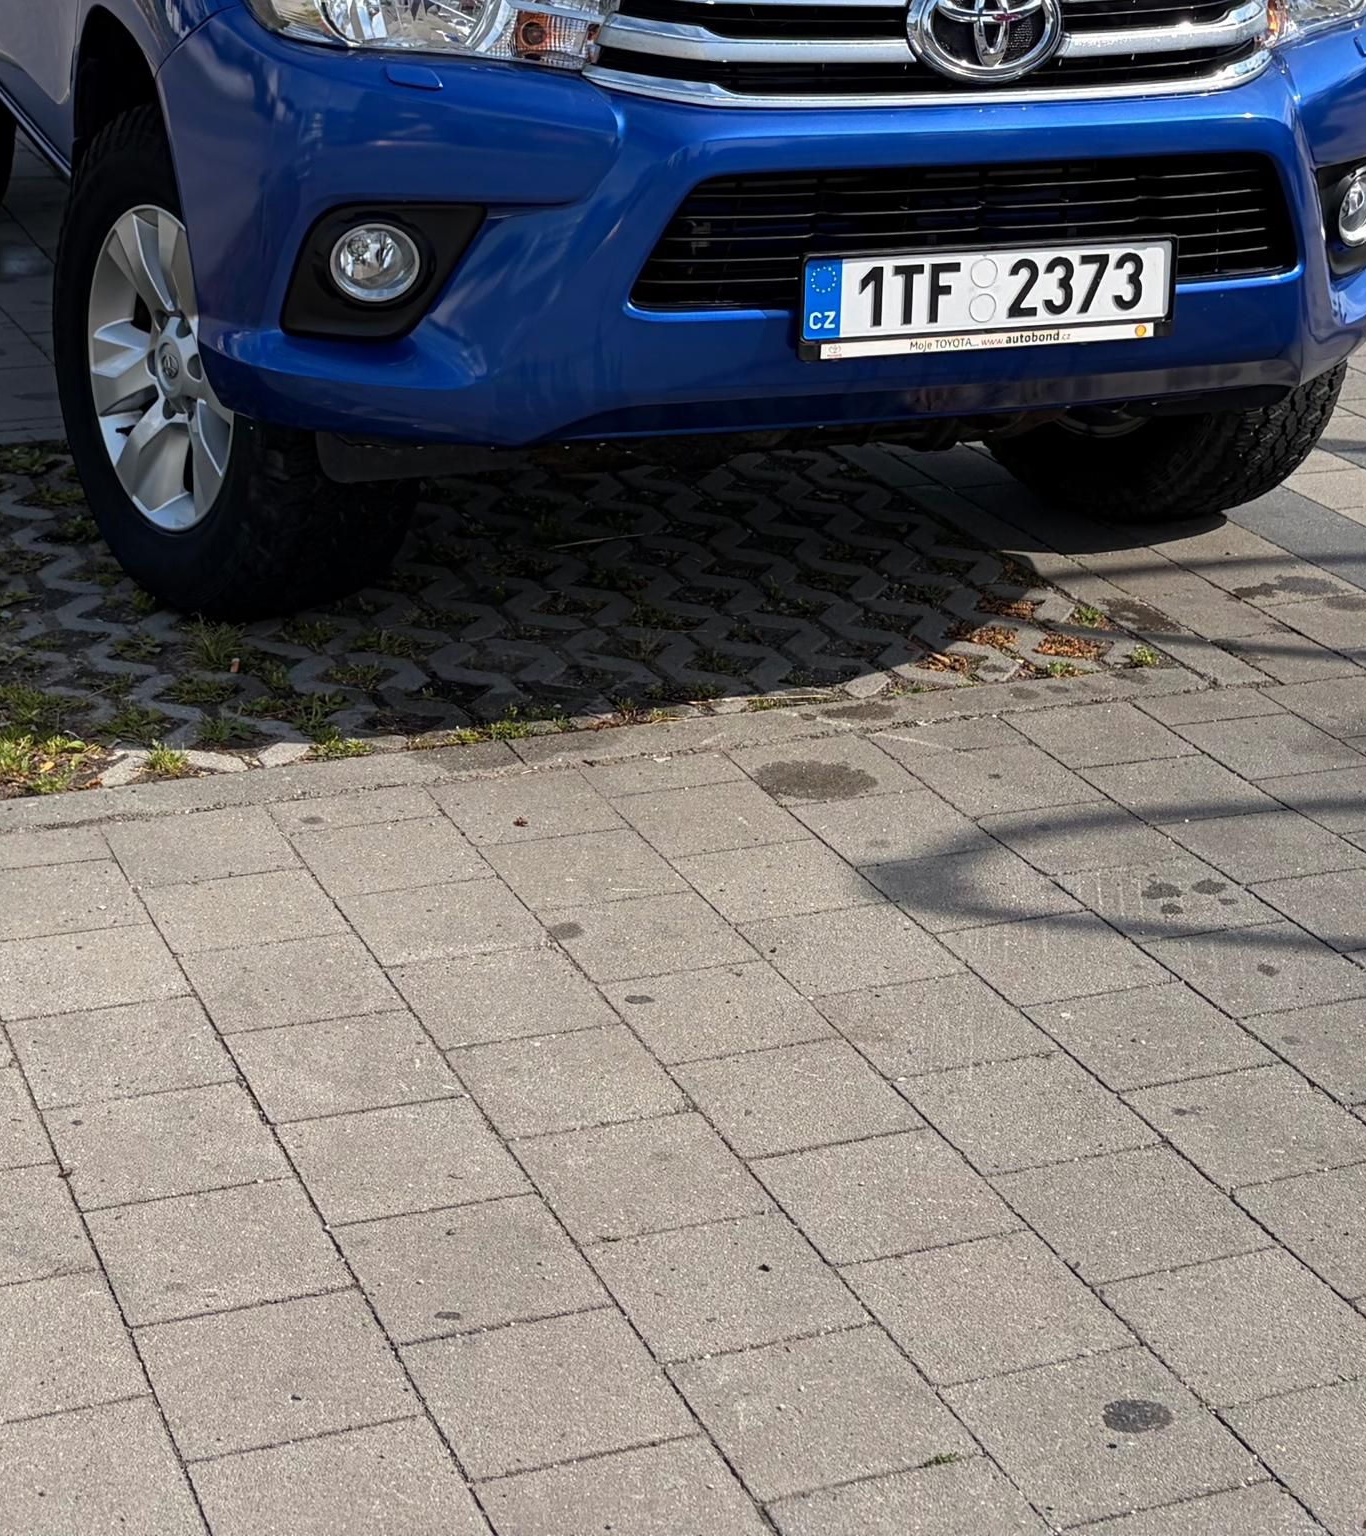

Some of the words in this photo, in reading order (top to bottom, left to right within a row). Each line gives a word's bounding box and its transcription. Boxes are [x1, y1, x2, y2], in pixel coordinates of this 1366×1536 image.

[858, 262, 961, 328] 1TF
[1006, 252, 1144, 319] 2373
[809, 311, 837, 329] CZ
[909, 341, 933, 353] Moje
